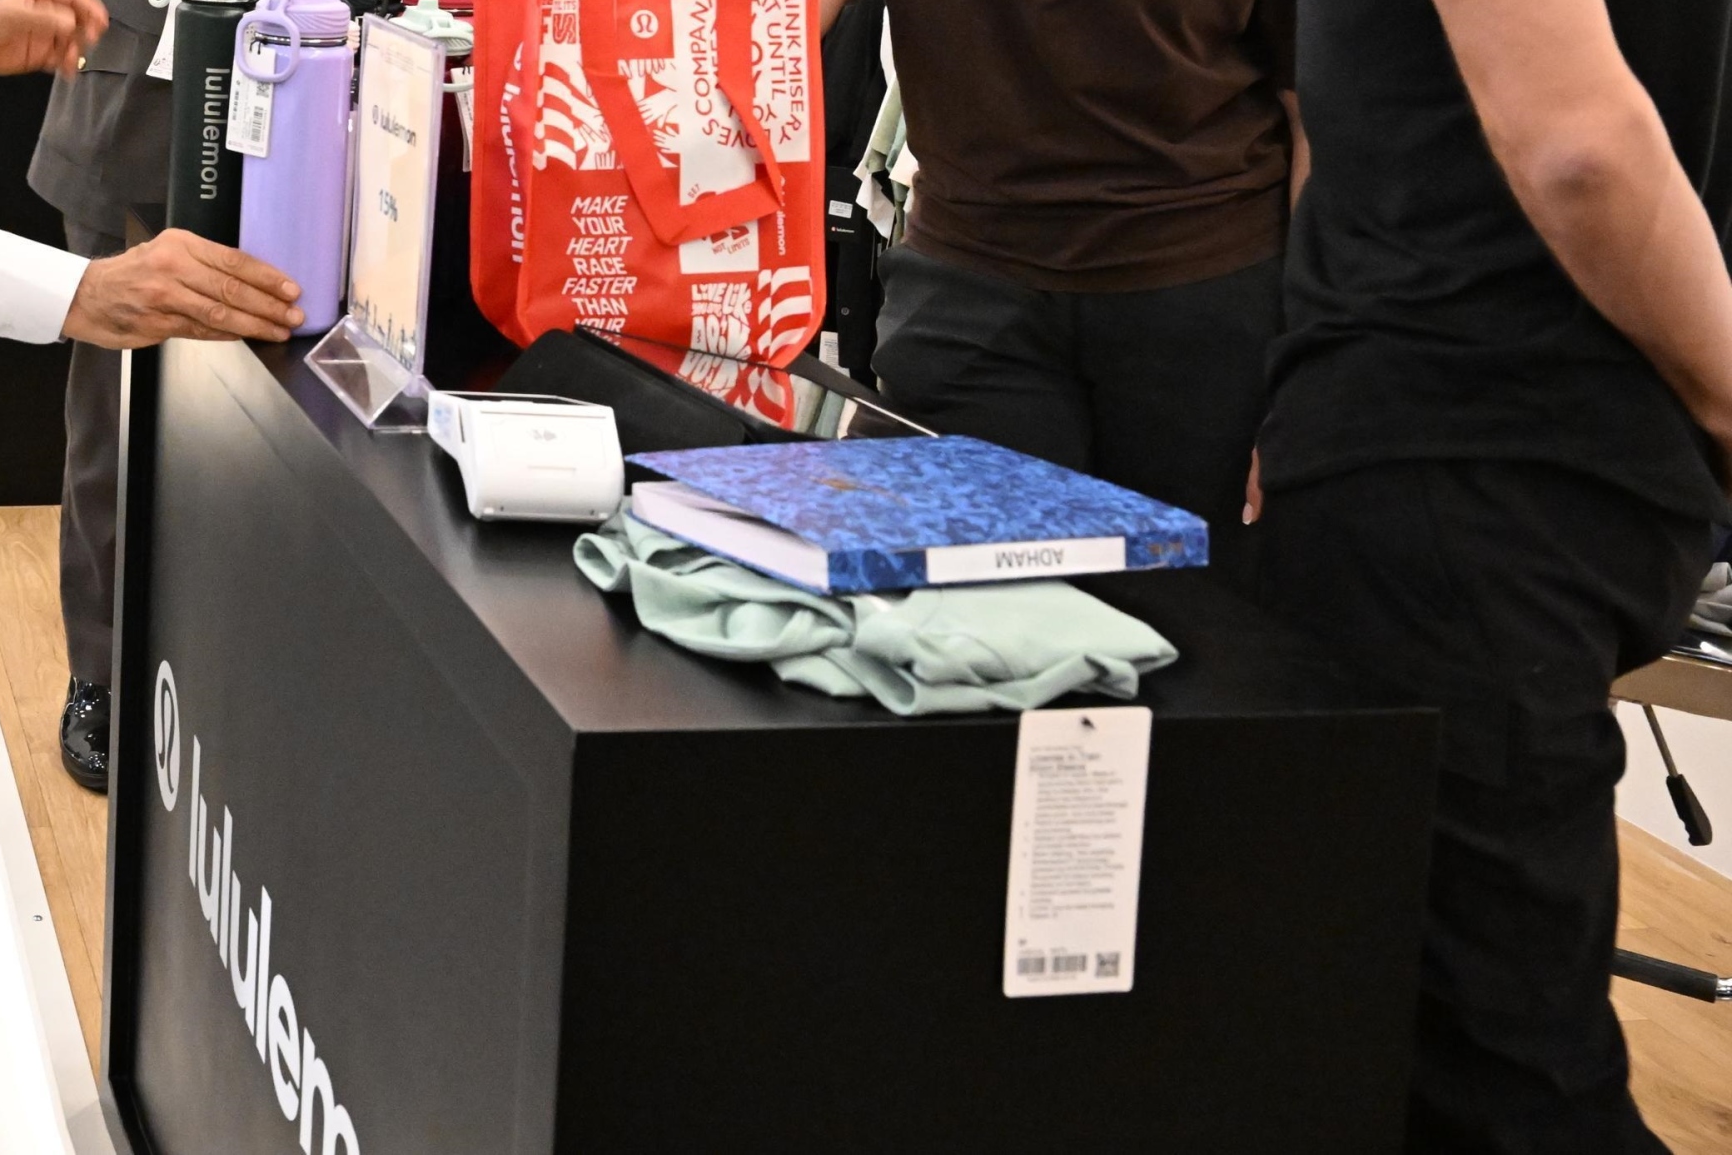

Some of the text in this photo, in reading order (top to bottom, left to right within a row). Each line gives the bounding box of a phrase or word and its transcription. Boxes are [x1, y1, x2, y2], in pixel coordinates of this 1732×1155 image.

[768, 23, 786, 100] UNTIL
[779, 57, 805, 145] MISERY
[200, 68, 231, 200] lululemon
[380, 110, 417, 147] lululemon
[378, 188, 399, 223] 15%
[570, 195, 629, 215] MAKE
[572, 216, 627, 235] YOUR
[566, 236, 633, 256] HEART
[711, 242, 727, 255] NOT
[572, 257, 627, 276] RACE
[561, 277, 638, 295] FASTER
[571, 297, 629, 316] THAN
[994, 547, 1065, 569] ADHAM
